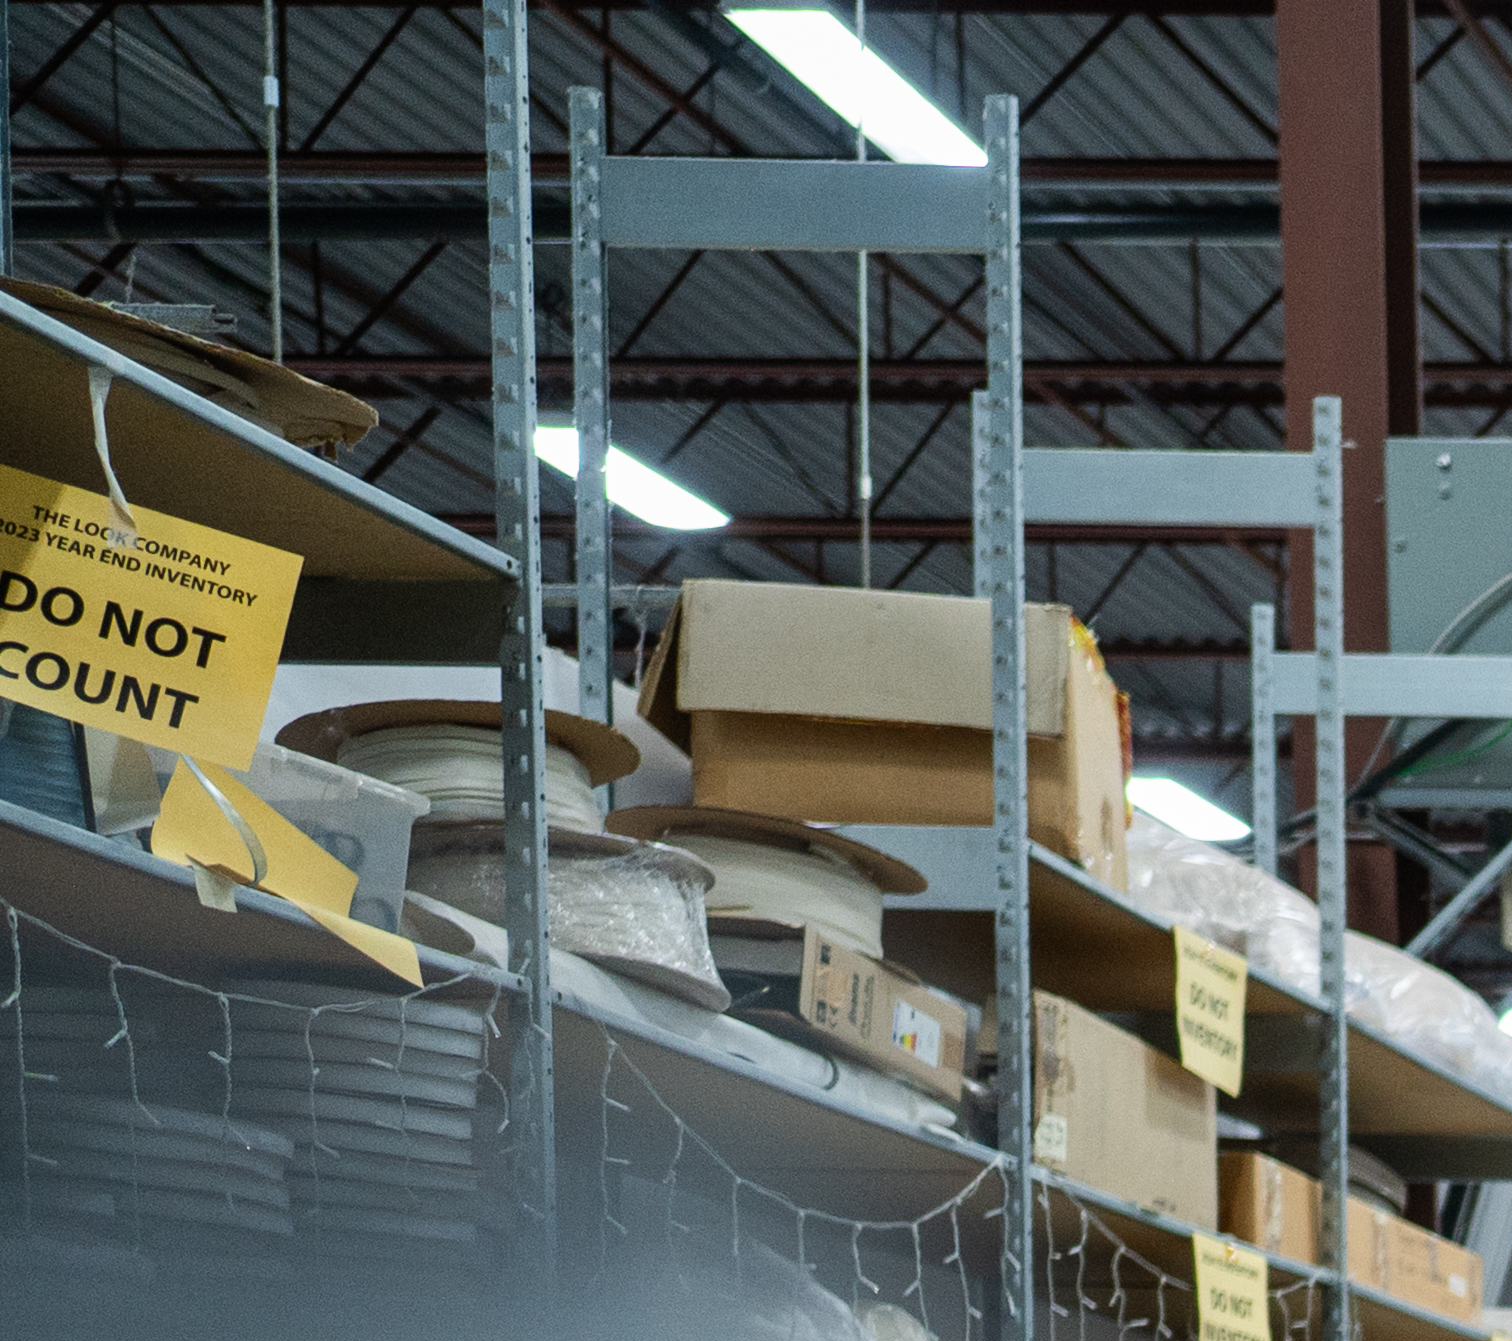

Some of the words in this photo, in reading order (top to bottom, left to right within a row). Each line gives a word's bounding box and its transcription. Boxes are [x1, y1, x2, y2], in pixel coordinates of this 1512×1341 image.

[33, 505, 71, 529] THE
[74, 518, 129, 547] LOOK
[132, 536, 231, 577] COMPANY
[45, 532, 96, 560] YEAR
[99, 549, 141, 573] END
[145, 562, 258, 608] INVENTORY
[0, 570, 85, 628] DO
[98, 600, 227, 669] NOT
[0, 640, 200, 729] COUNT
